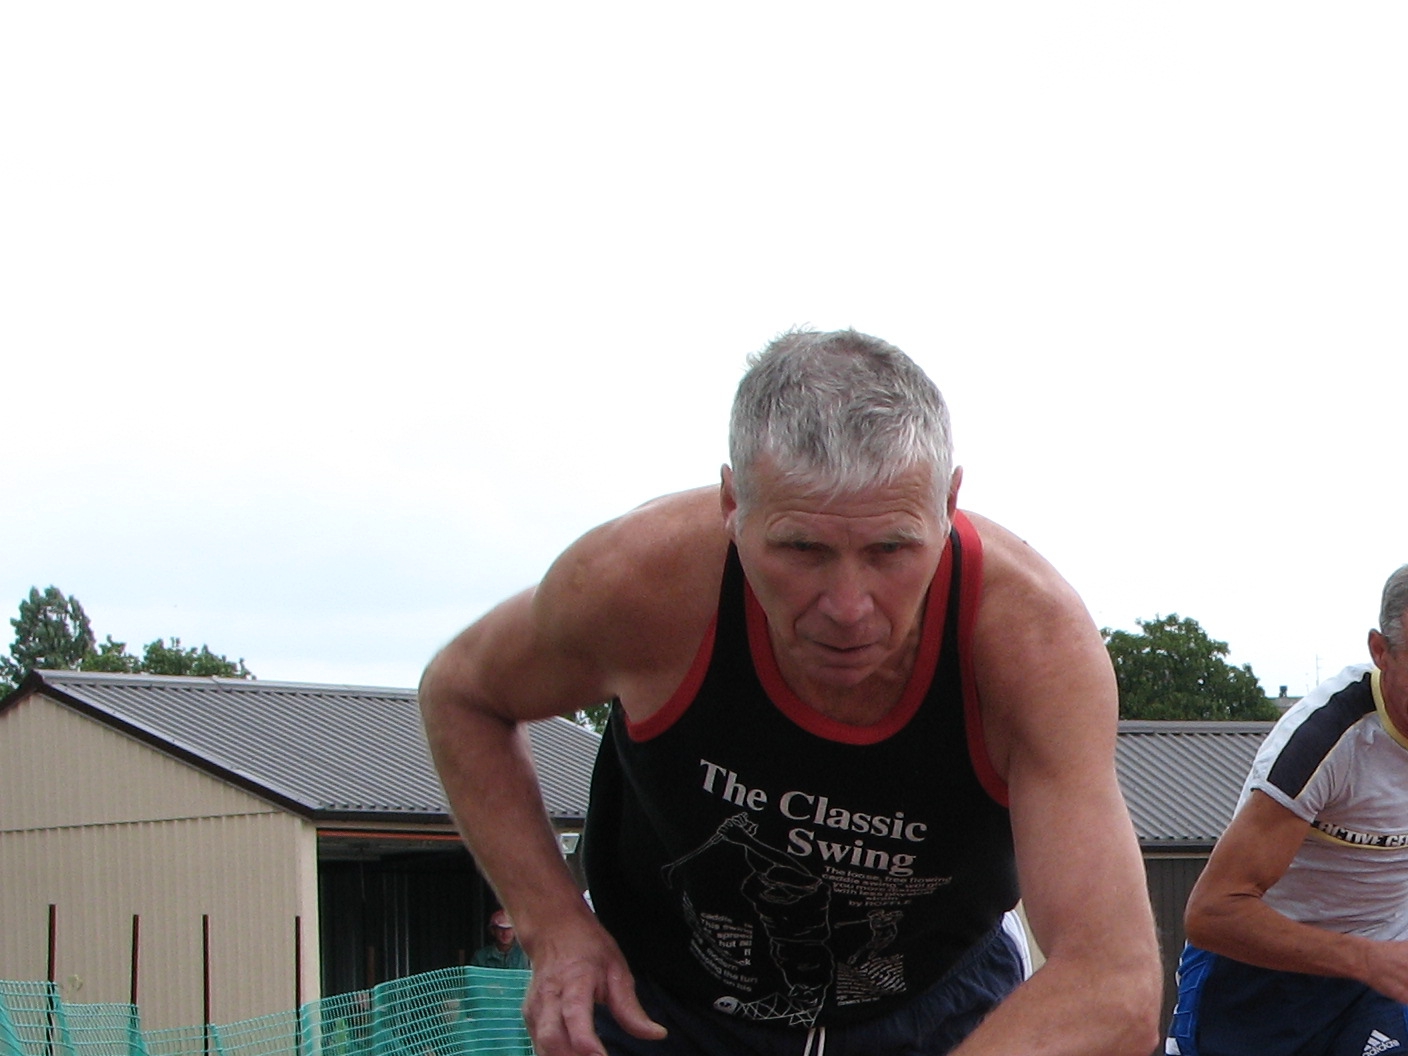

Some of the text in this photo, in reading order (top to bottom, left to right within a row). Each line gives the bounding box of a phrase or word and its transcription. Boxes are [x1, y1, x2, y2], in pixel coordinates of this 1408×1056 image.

[701, 758, 928, 842] The Classic
[787, 828, 917, 876] Swing
[1317, 822, 1384, 846] ACTIVE
